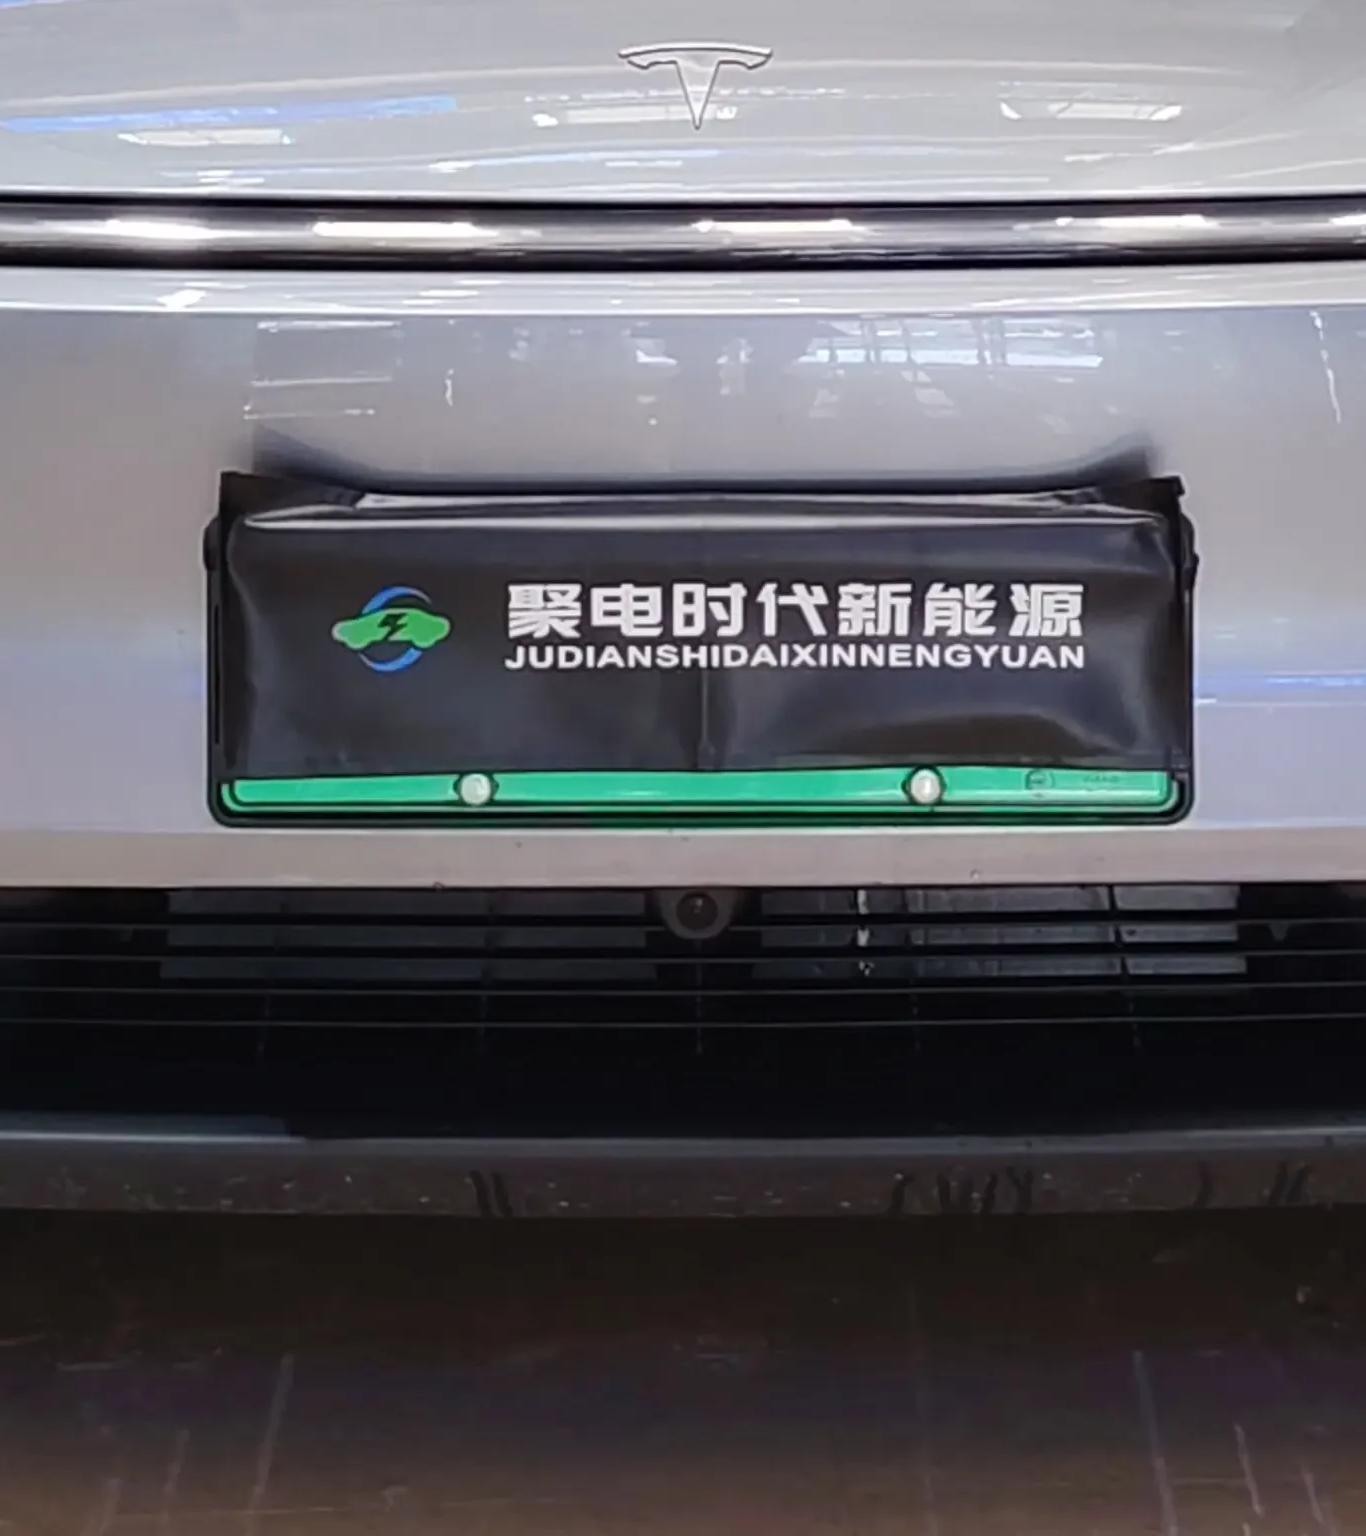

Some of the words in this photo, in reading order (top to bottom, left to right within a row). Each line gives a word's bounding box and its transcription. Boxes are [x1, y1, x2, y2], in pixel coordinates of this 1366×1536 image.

[507, 582, 1085, 640] 聚电时代新能源
[504, 644, 1085, 670] JUDIANSHIDAIXINNENGYUAN
